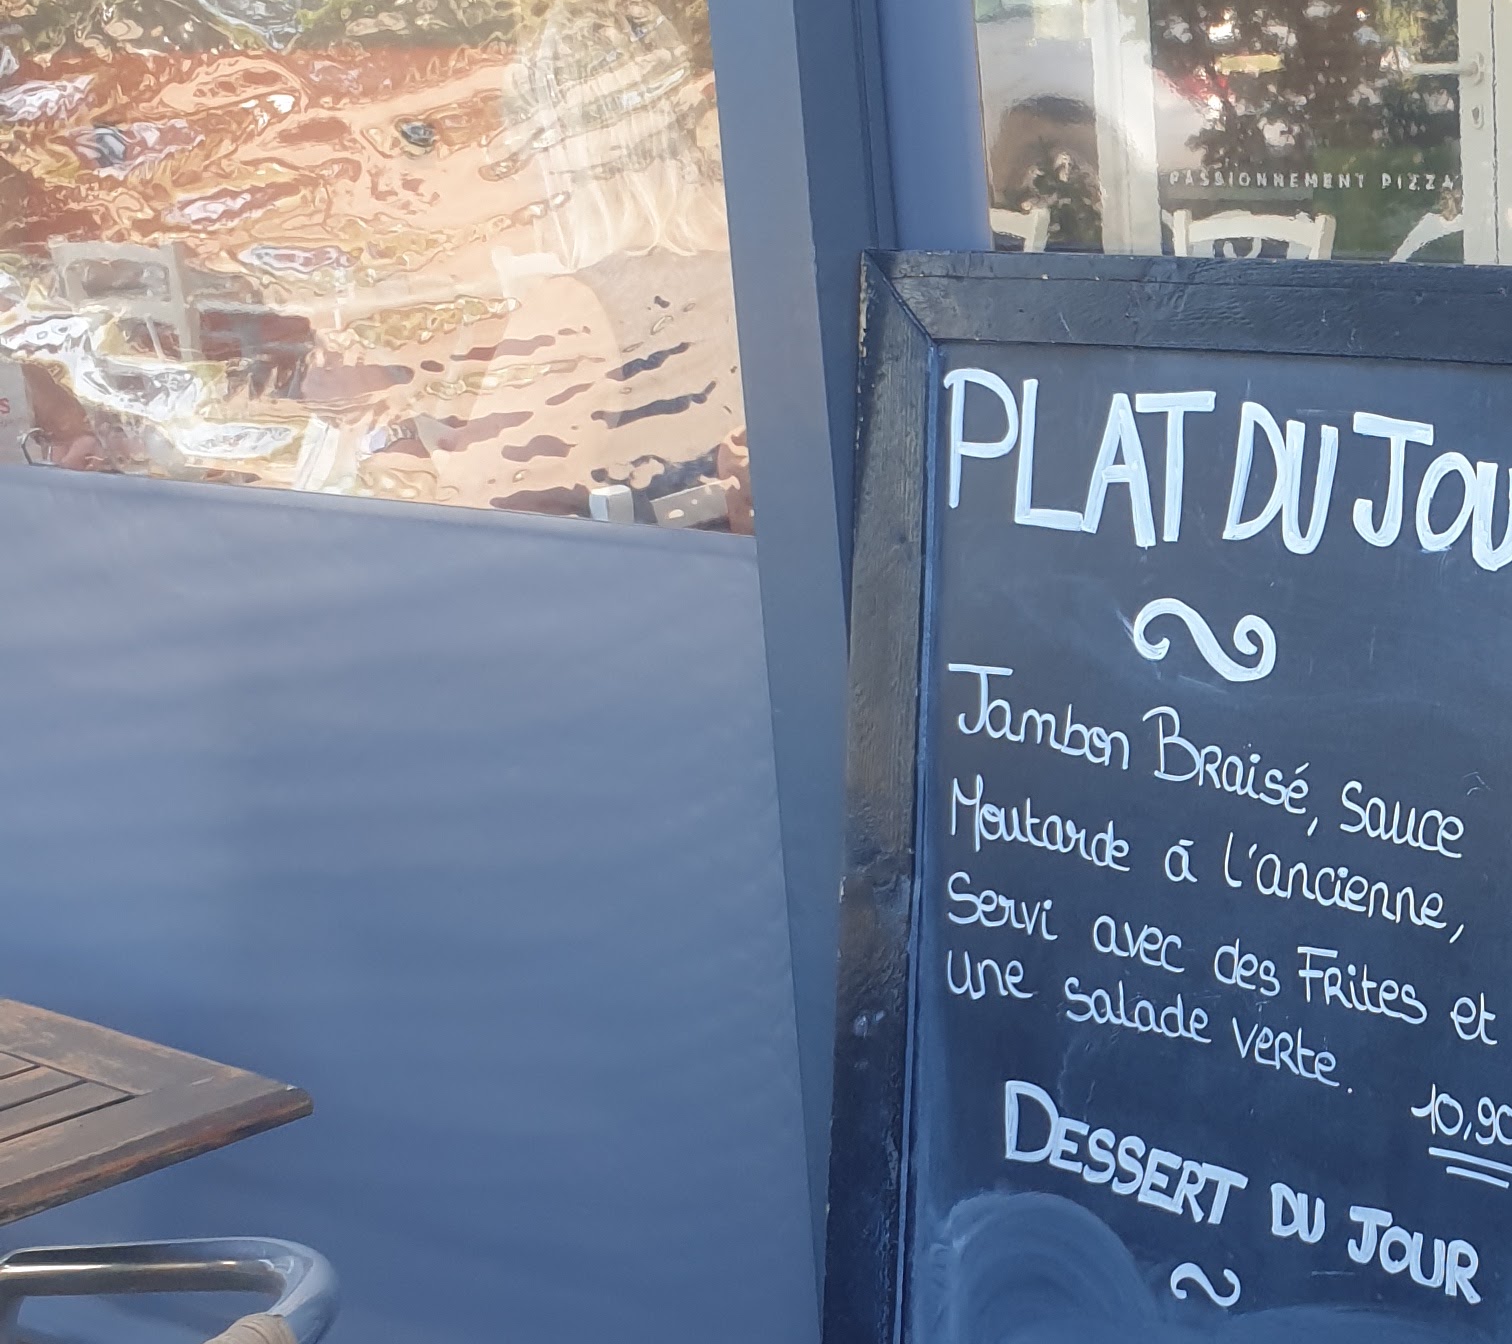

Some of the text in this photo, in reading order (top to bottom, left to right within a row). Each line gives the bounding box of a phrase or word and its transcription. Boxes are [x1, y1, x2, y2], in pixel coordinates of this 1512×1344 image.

[1169, 170, 1456, 191] PASSIONNEMENT PIZZA
[944, 368, 1216, 549] PLAT
[1222, 402, 1338, 554] DU
[948, 664, 1129, 770] Jambon
[950, 774, 1130, 872] Moutarde
[1224, 832, 1465, 944] l'ancienne,
[1094, 916, 1185, 973] avec
[1214, 938, 1281, 996] des
[1450, 992, 1498, 1045] et
[1005, 1081, 1482, 1304] DESSERT DU JOUR
